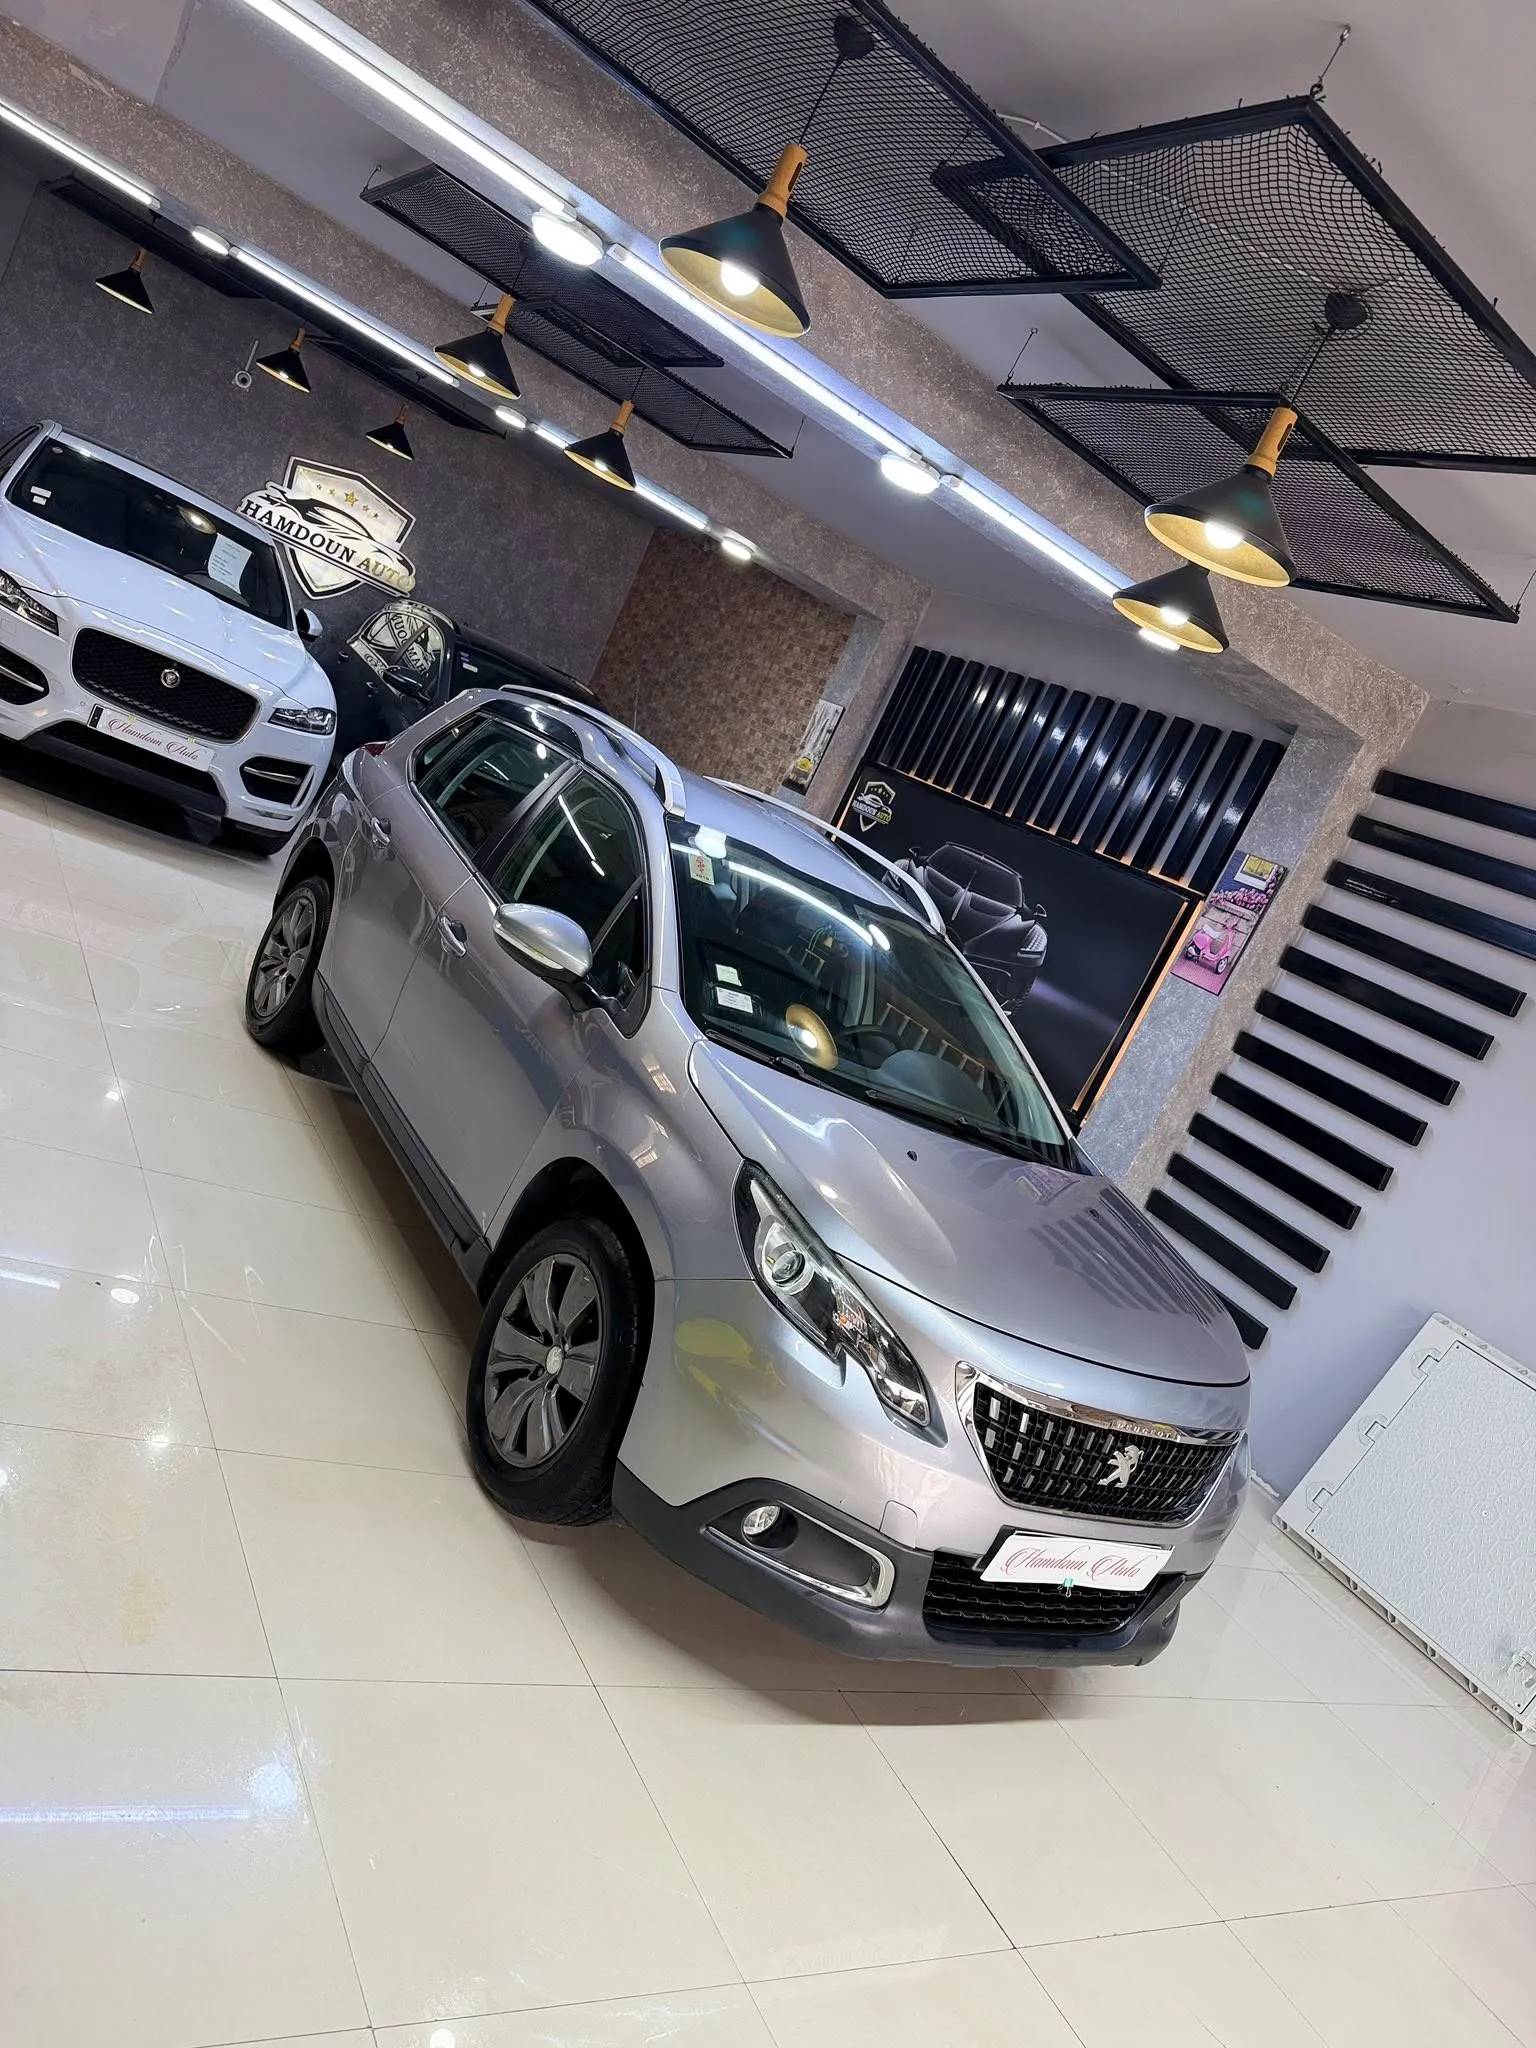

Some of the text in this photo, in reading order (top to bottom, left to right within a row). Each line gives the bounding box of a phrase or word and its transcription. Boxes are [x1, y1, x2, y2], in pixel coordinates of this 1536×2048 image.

[241, 499, 413, 588] HAMDOUN AUTO
[107, 718, 207, 761] Hamdoun Auto
[876, 810, 891, 822] AUTO
[1117, 1422, 1172, 1439] PEUGEOT
[1001, 1545, 1158, 1579] Hamdoun Auto
